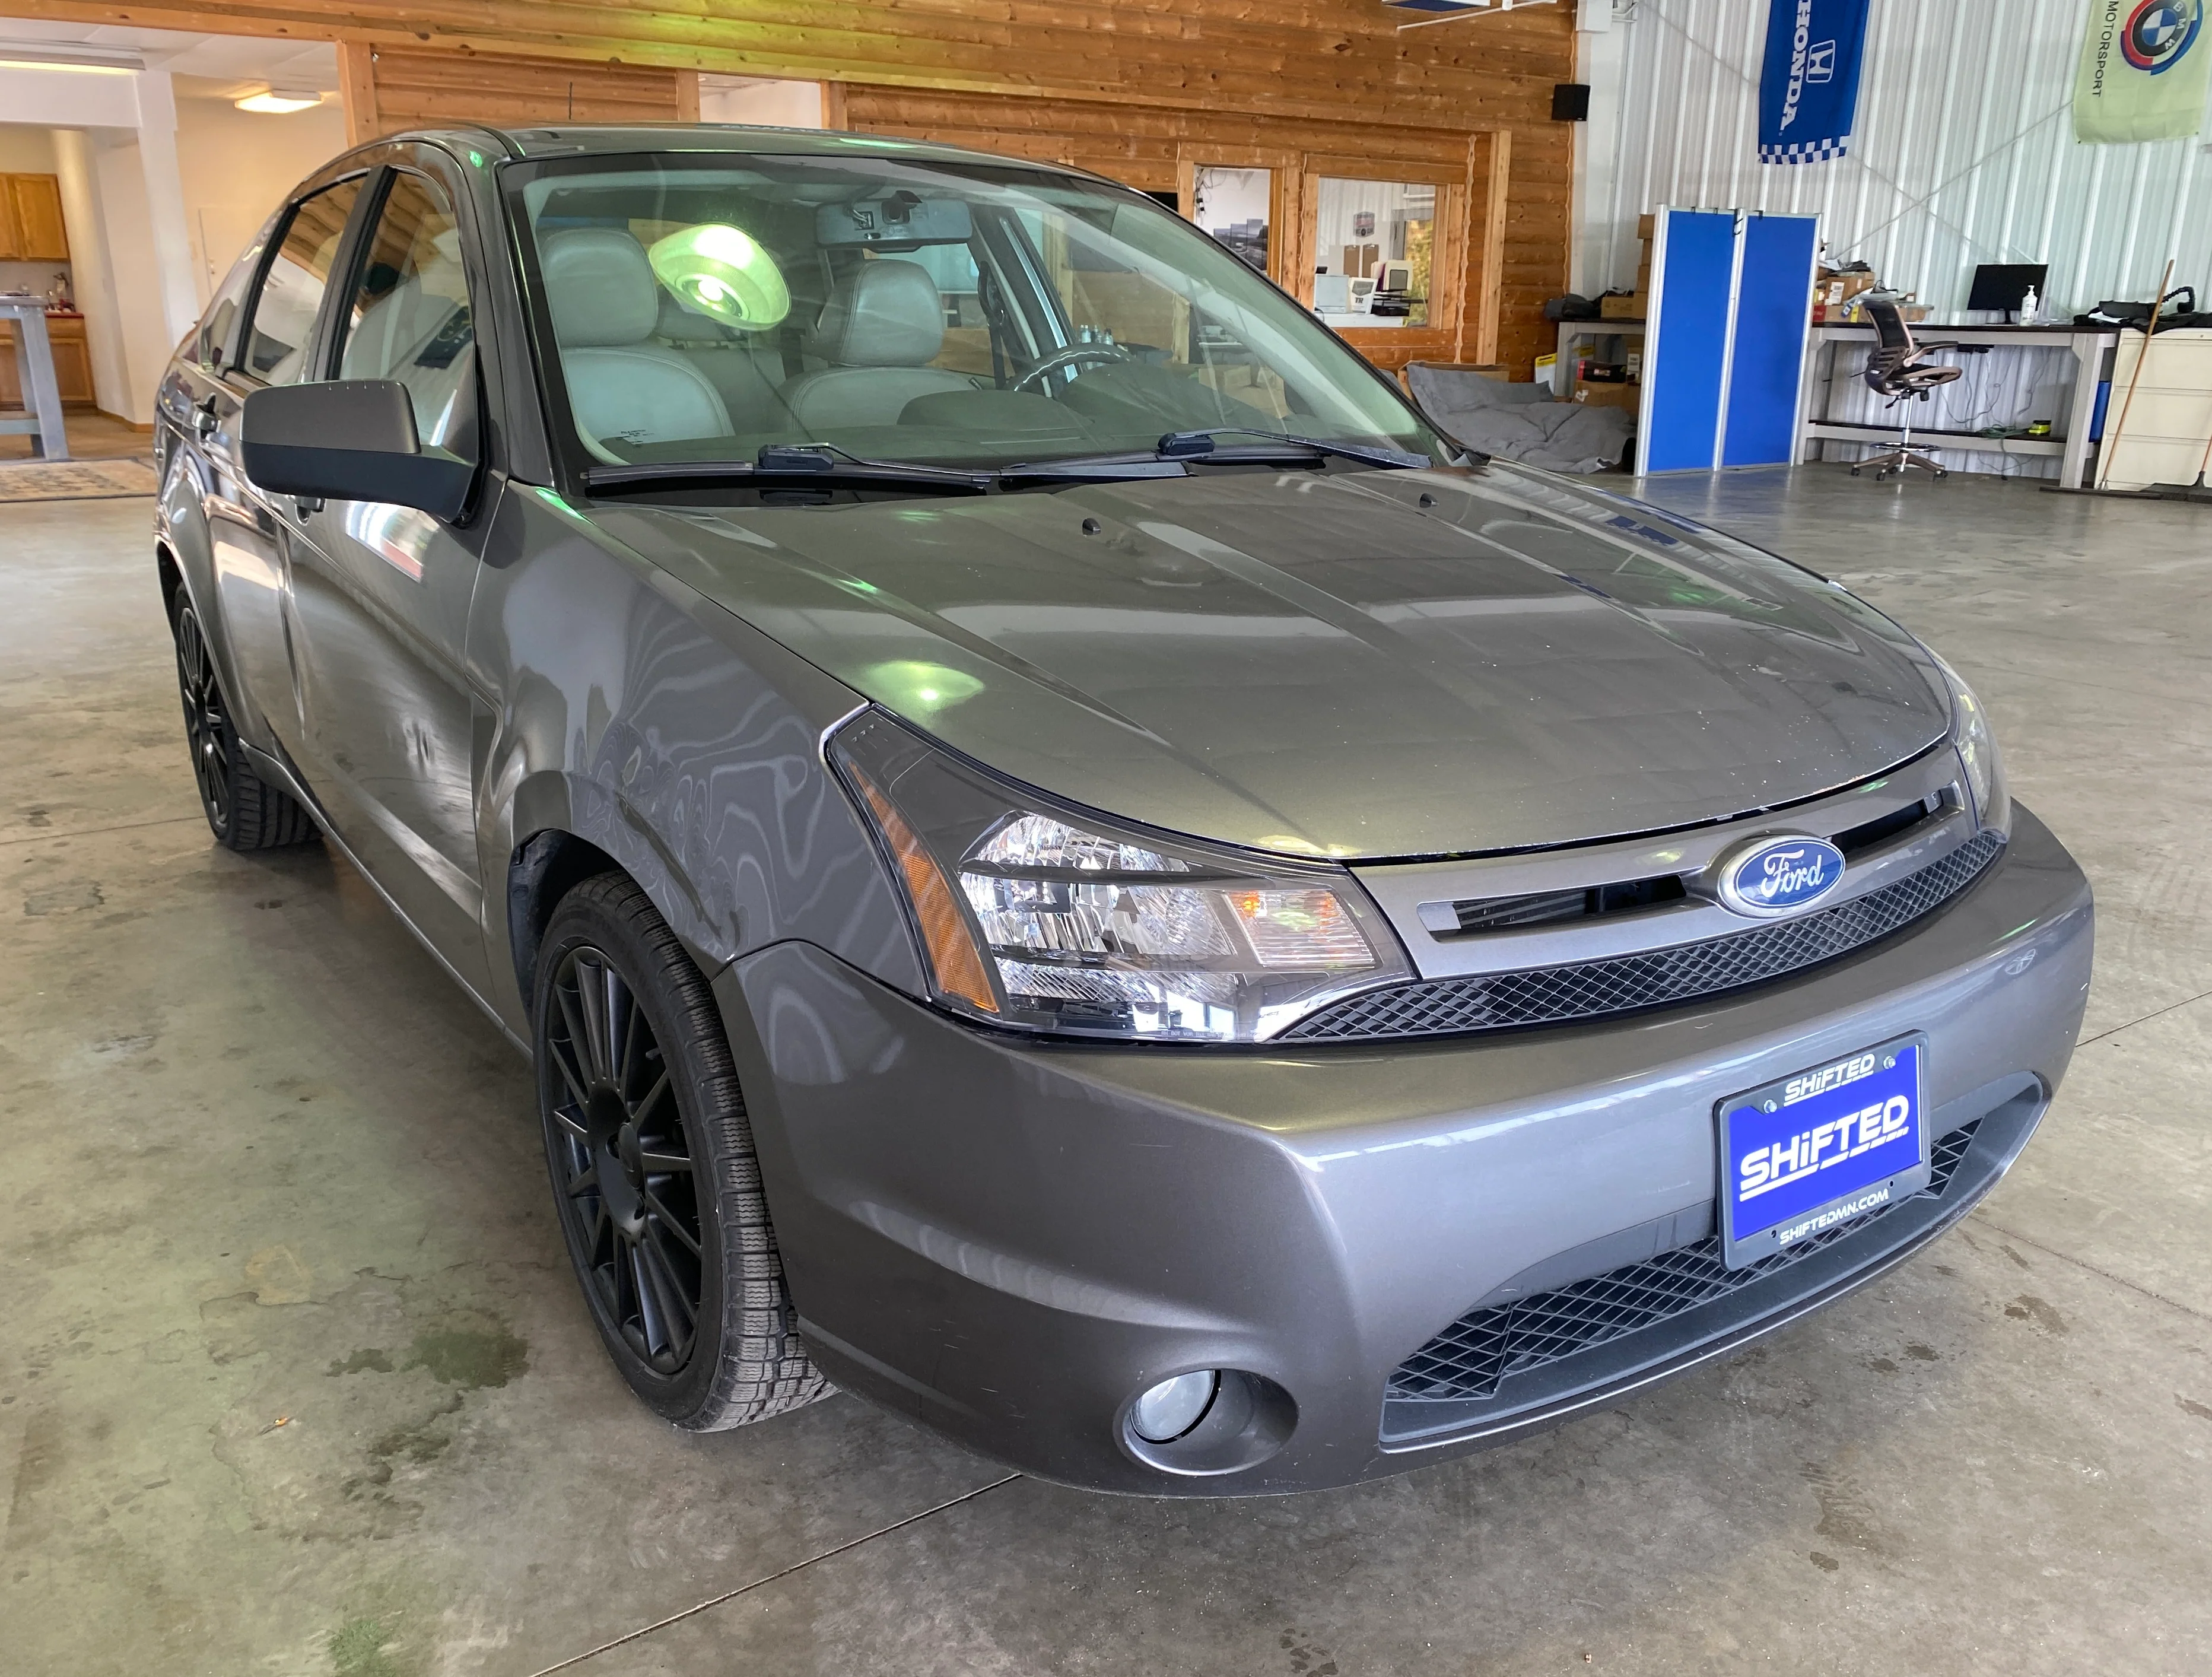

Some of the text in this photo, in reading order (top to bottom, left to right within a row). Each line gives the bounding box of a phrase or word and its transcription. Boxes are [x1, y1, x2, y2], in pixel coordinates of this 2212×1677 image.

[2092, 1, 2119, 97] MOTORSPORT
[2165, 1, 2187, 50] BMW
[1779, 0, 1811, 131] HONDA
[1760, 849, 1824, 898] Ford
[1779, 1188, 1889, 1246] SHIFTEDMN.COM
